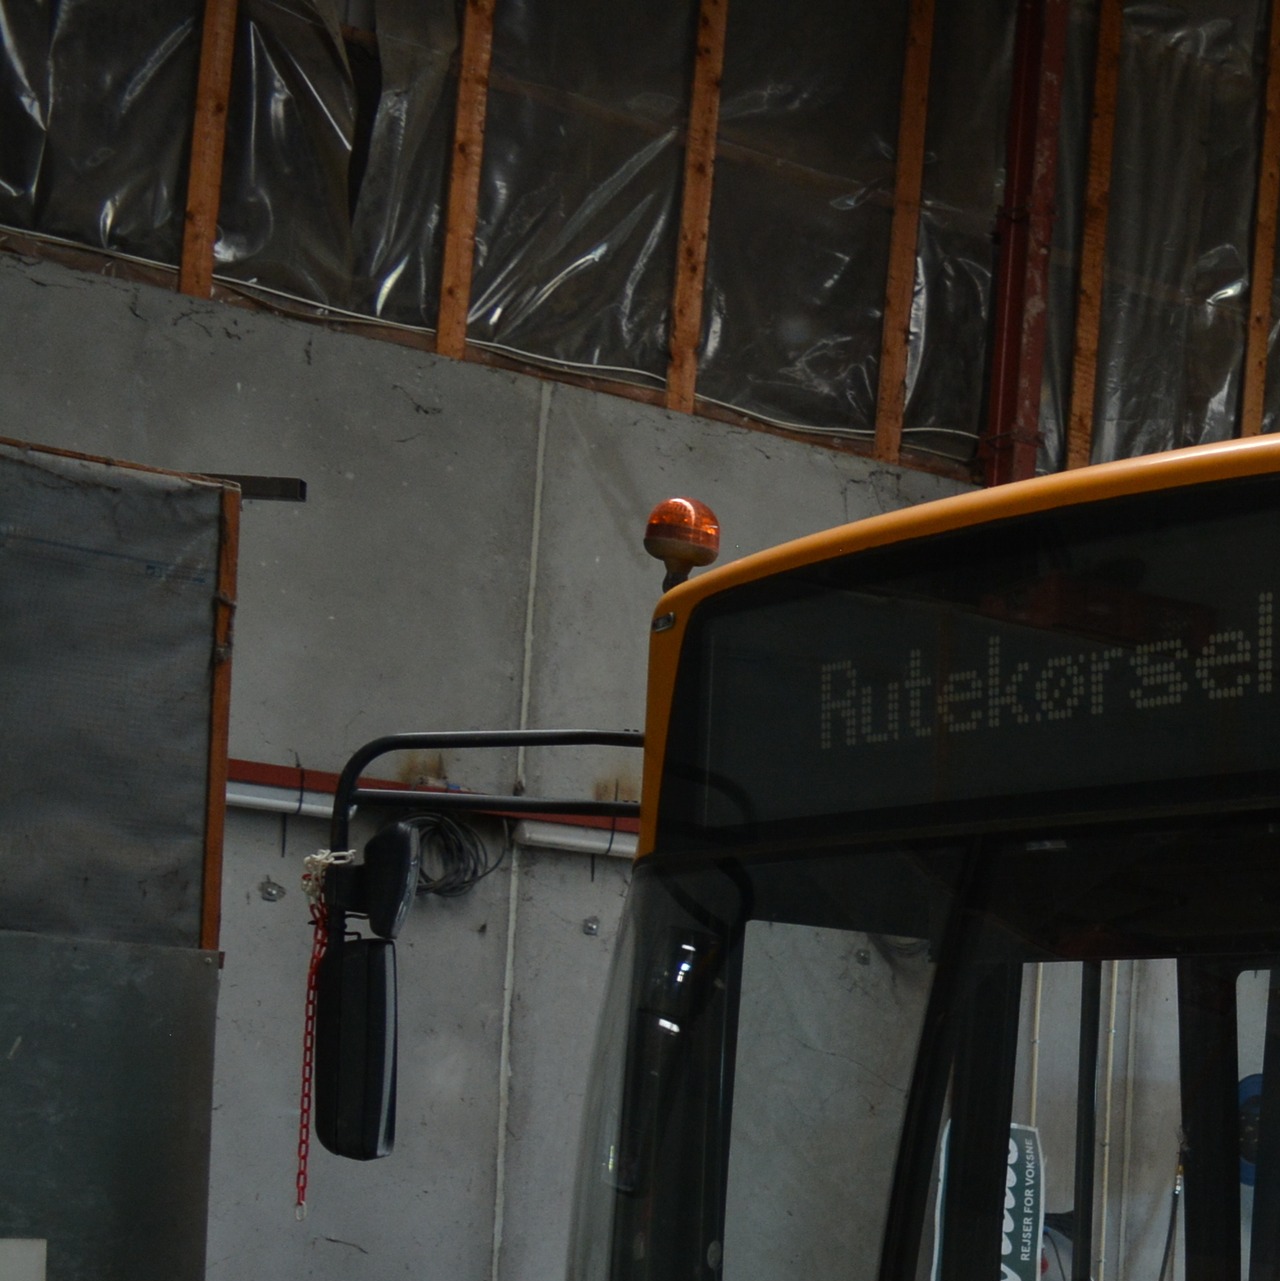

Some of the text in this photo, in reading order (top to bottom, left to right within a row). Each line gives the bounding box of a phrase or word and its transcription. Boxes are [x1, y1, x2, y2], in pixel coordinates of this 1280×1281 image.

[1019, 1137, 1036, 1262] REJSER FOR VOKSNE
